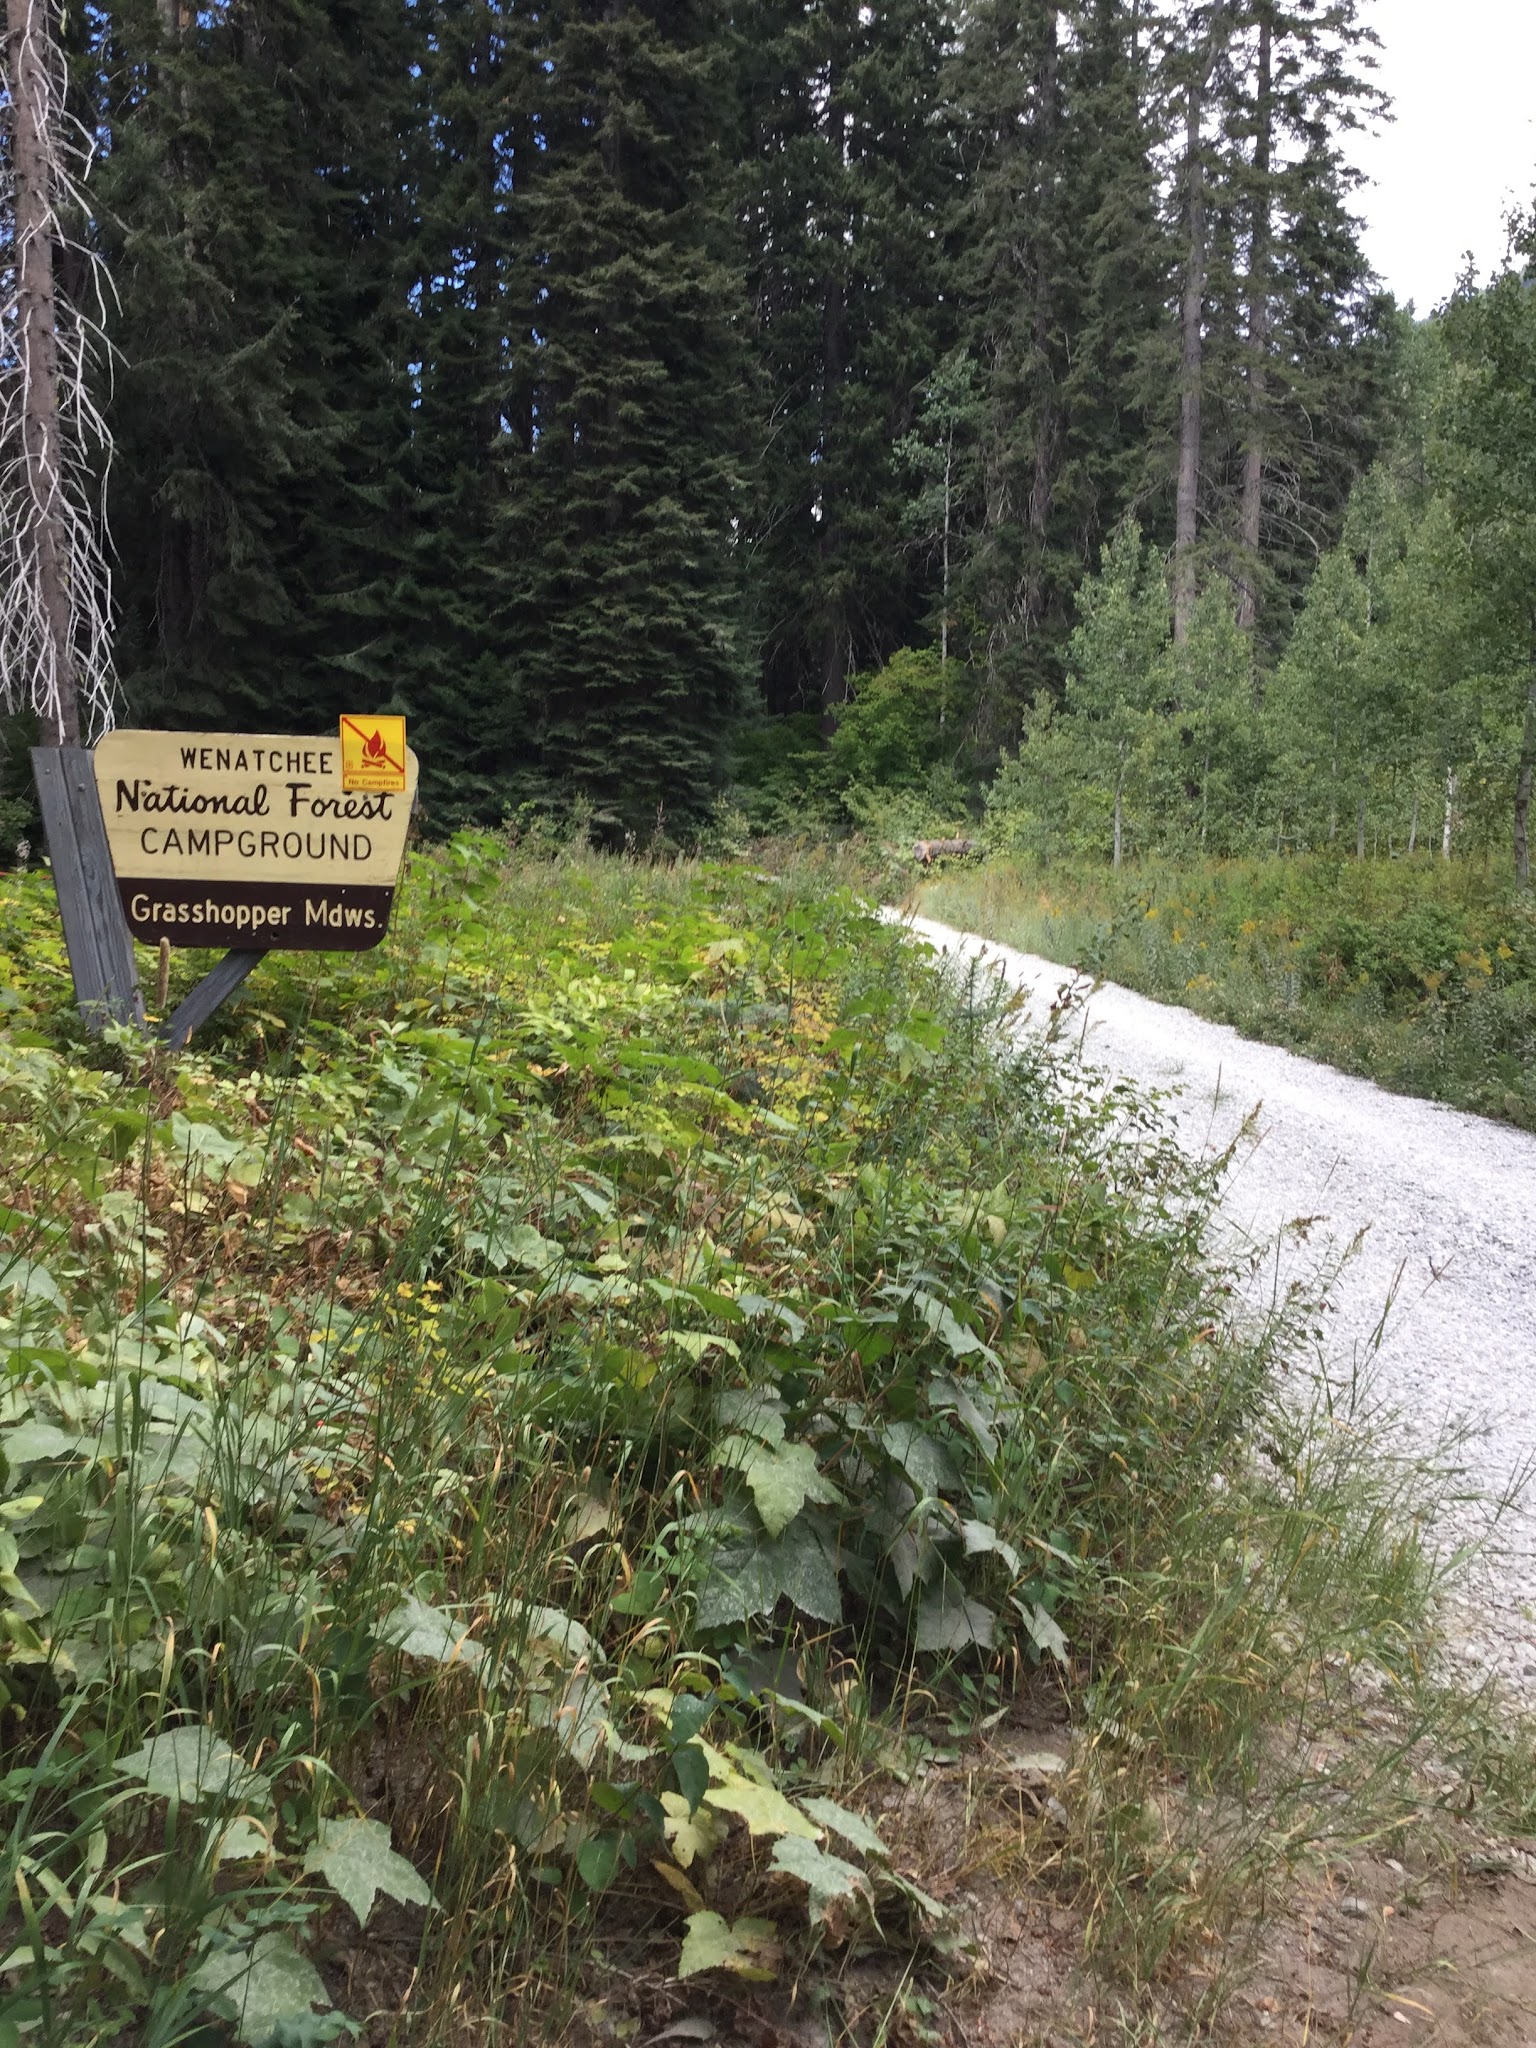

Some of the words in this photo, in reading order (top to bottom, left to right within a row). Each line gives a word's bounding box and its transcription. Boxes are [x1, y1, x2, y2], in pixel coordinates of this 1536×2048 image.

[180, 747, 333, 775] WENATCHEE
[362, 778, 400, 787] Campfires
[116, 779, 270, 816] National
[285, 782, 396, 821] Forest
[140, 827, 372, 861] CAMPGROUND
[131, 893, 292, 930] Grasshopper
[304, 898, 384, 930] Mdws.
